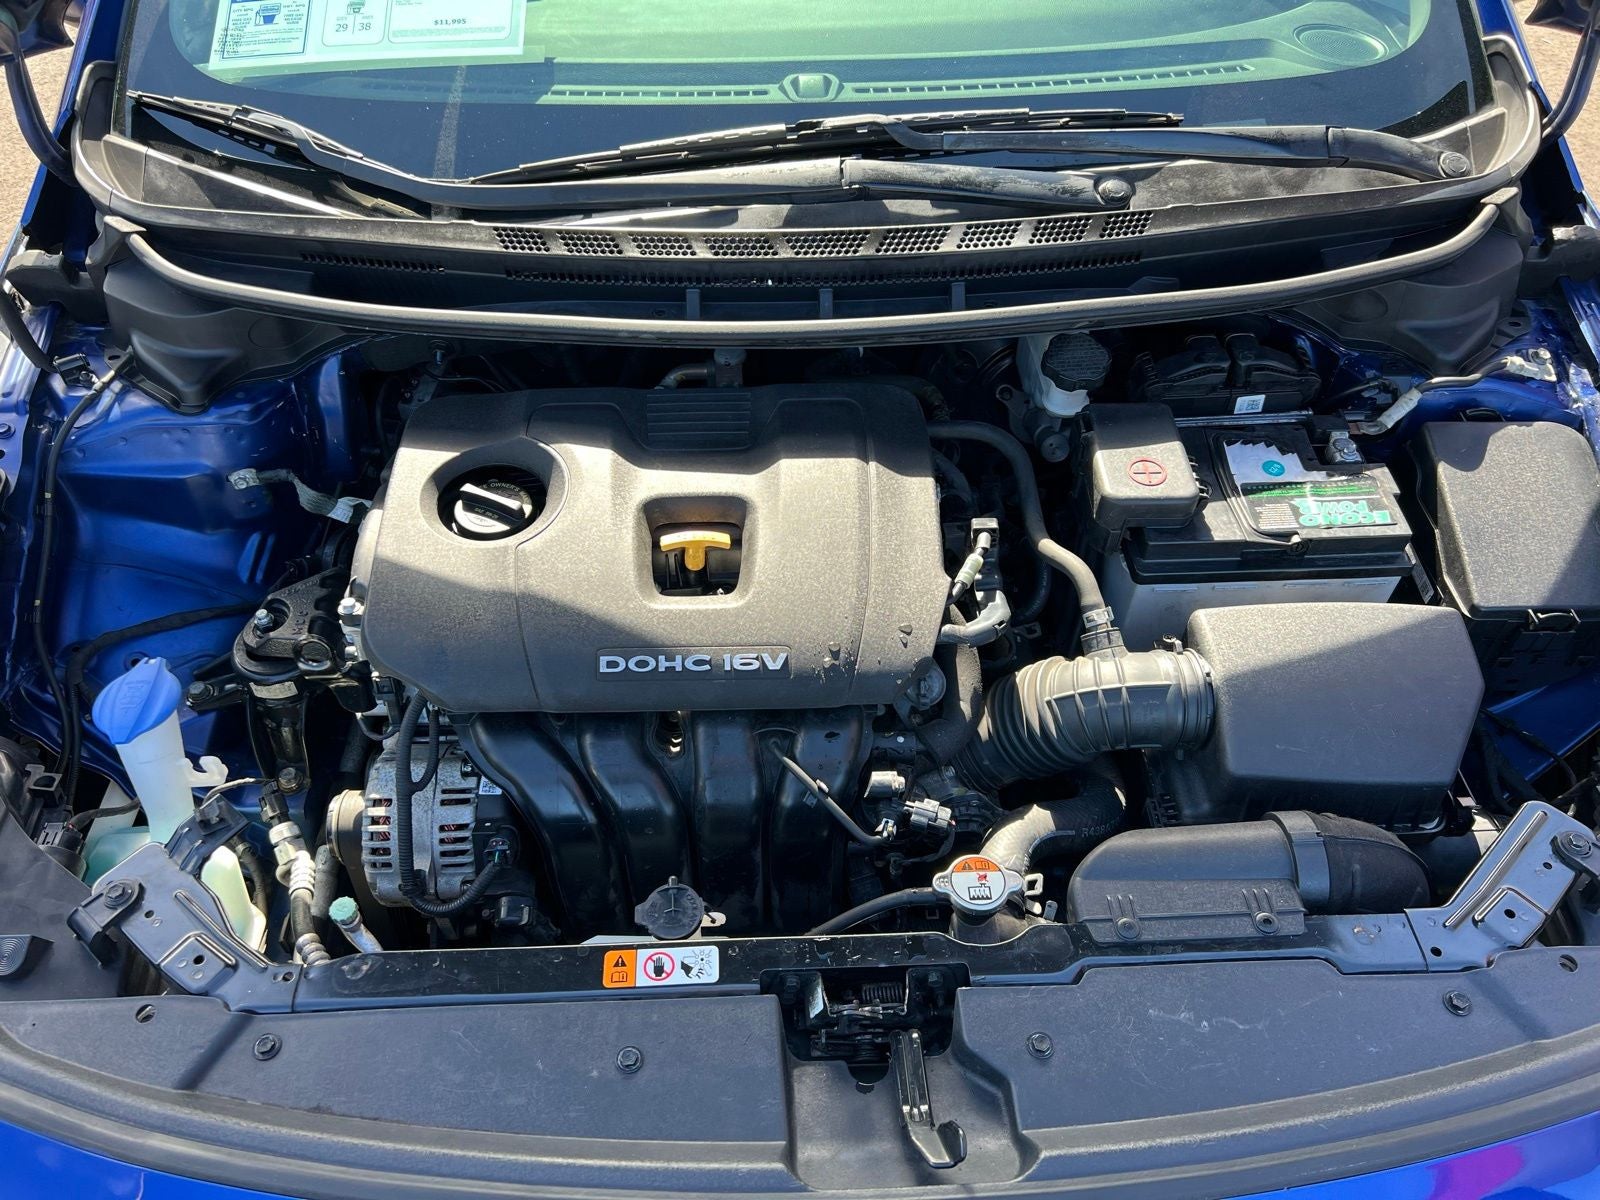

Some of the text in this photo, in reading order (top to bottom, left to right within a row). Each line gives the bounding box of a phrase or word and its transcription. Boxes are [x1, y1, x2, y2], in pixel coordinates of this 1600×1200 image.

[335, 22, 372, 32] 29 38
[433, 18, 467, 26] $11,995
[1298, 510, 1391, 527] ECONO
[599, 652, 789, 673] DOHC 16V
